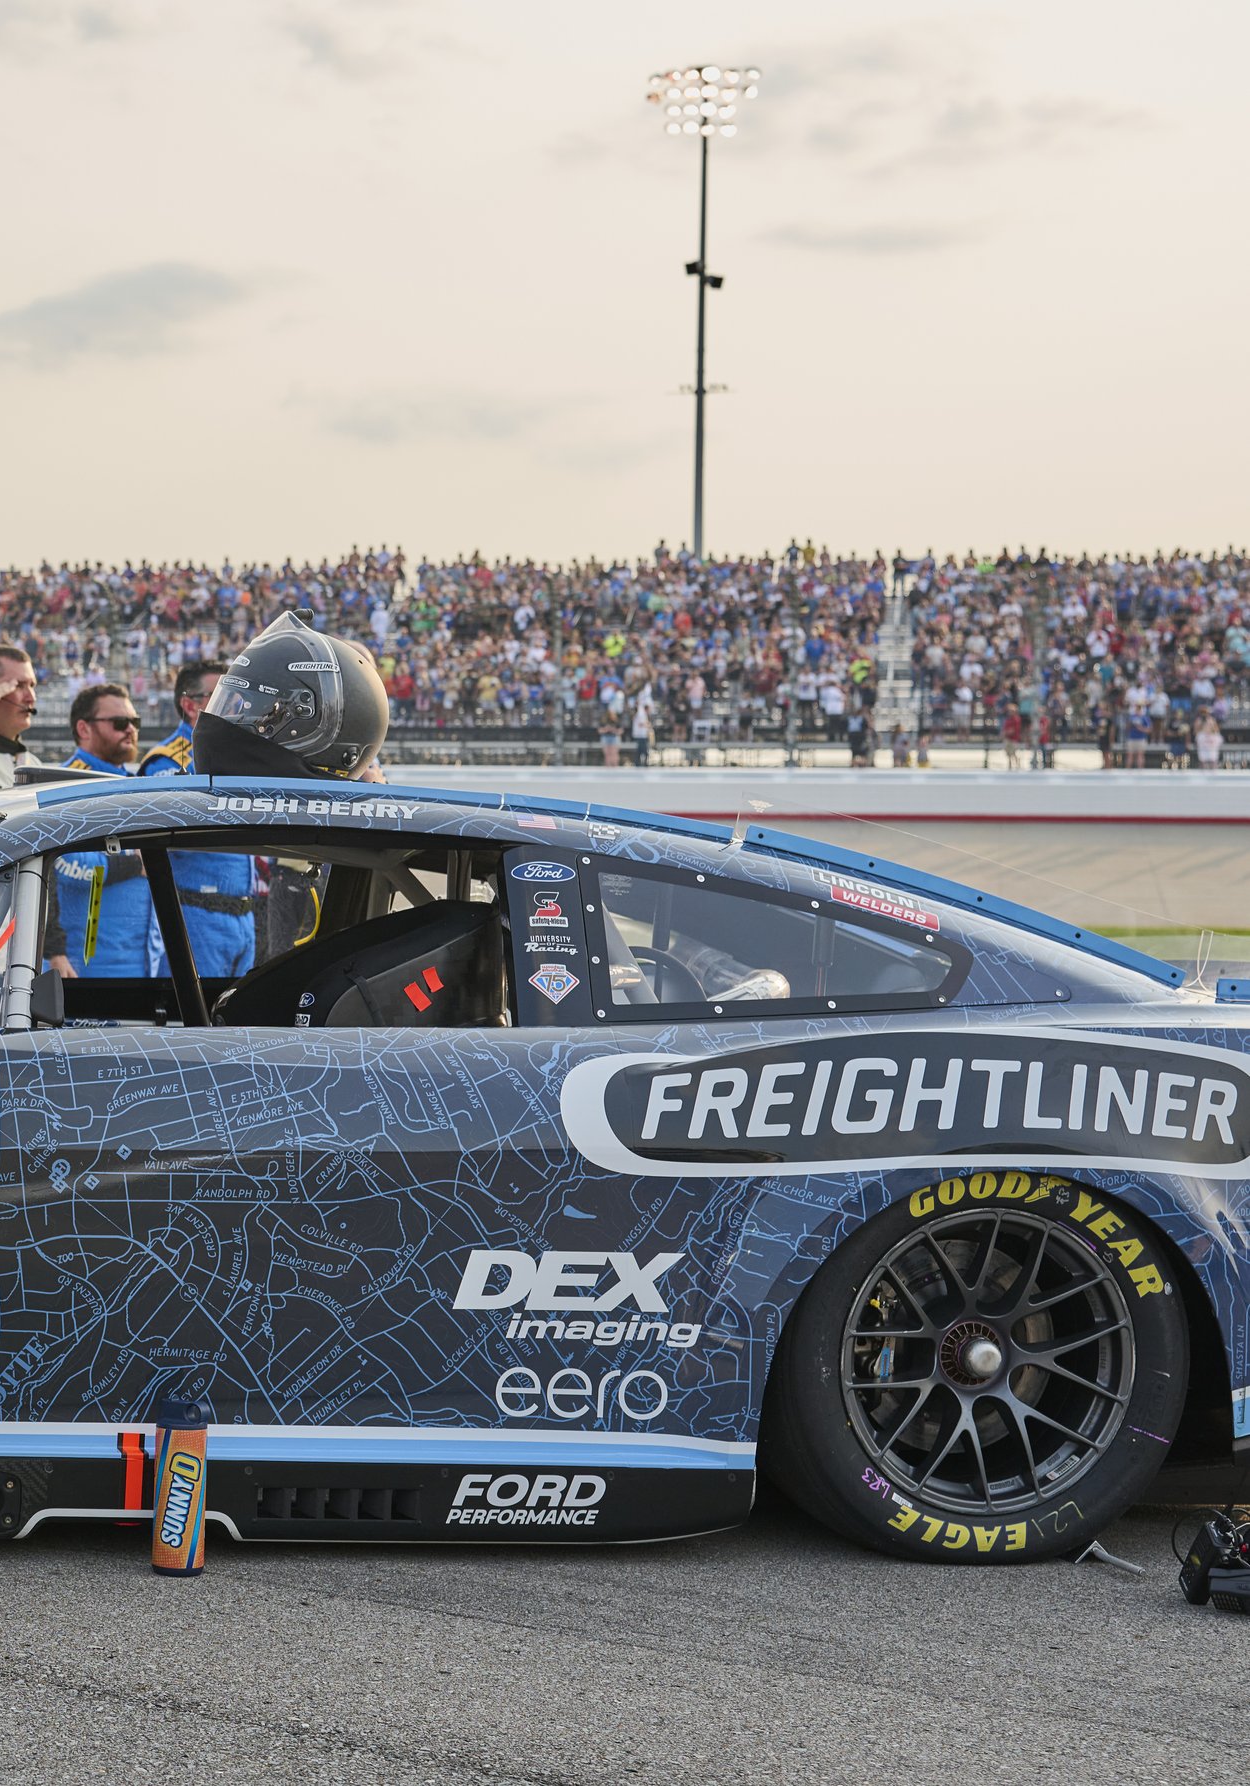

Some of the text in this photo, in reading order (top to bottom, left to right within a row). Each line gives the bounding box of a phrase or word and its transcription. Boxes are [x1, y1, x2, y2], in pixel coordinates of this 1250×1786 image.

[208, 797, 299, 814] JOSH
[307, 800, 421, 820] BERRY
[524, 863, 564, 879] Ford
[818, 871, 916, 909] LINCOLN
[842, 890, 928, 924] WELDERS
[523, 942, 579, 956] Racing
[529, 935, 572, 943] UNIVERSITY
[540, 974, 567, 993] 75
[106, 1085, 158, 1113] GREENWAY
[640, 1057, 1238, 1145] FREIGHTLINER
[196, 1189, 271, 1199] RANDOLPH RD
[761, 1178, 814, 1201] MELCHOR
[300, 1223, 349, 1248] COLVILLE
[908, 1170, 1166, 1299] GOODYEAR
[273, 1251, 334, 1274] HEMPSTEAD
[182, 1284, 197, 1300] 16
[452, 1249, 687, 1313] DEX
[297, 1285, 348, 1317] CHEROKEE
[505, 1312, 703, 1349] imaging
[148, 1347, 228, 1363] HERMITAGE RD
[81, 1363, 120, 1403] BROMLEY
[282, 1357, 330, 1402] MIDDLETON
[495, 1365, 669, 1421] eero
[312, 1387, 352, 1424] HUNTLEY
[451, 1473, 607, 1508] FORD
[445, 1508, 600, 1525] PERFORMANCE
[886, 1504, 1028, 1552] EAGLE
